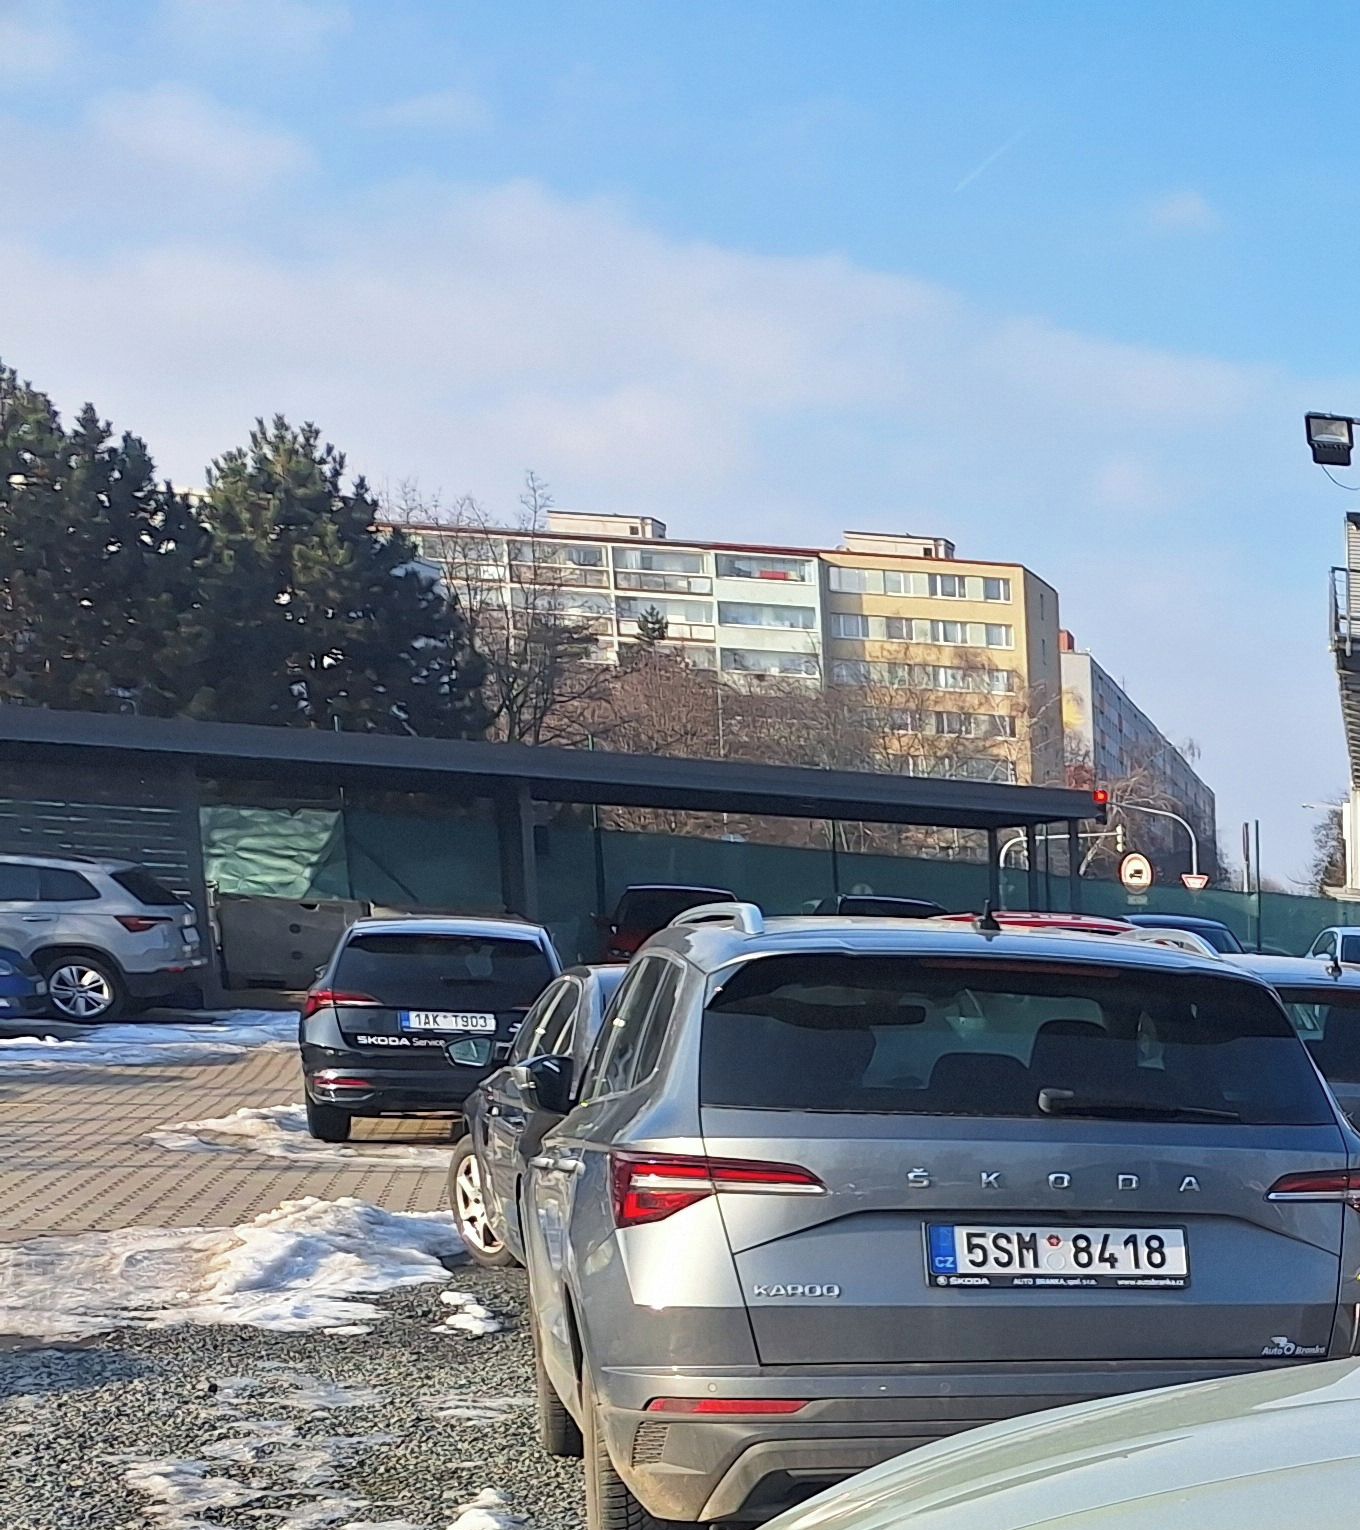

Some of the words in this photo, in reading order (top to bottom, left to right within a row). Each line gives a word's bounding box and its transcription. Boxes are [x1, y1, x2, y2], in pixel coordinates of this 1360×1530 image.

[415, 1014, 440, 1027] 1AK
[453, 1015, 488, 1028] T903
[906, 1168, 1201, 1192] ŠKODA
[966, 1232, 1040, 1269] 5SM
[1071, 1233, 1167, 1269] 8418
[934, 1256, 955, 1269] CZ
[753, 1284, 841, 1298] KAROQ
